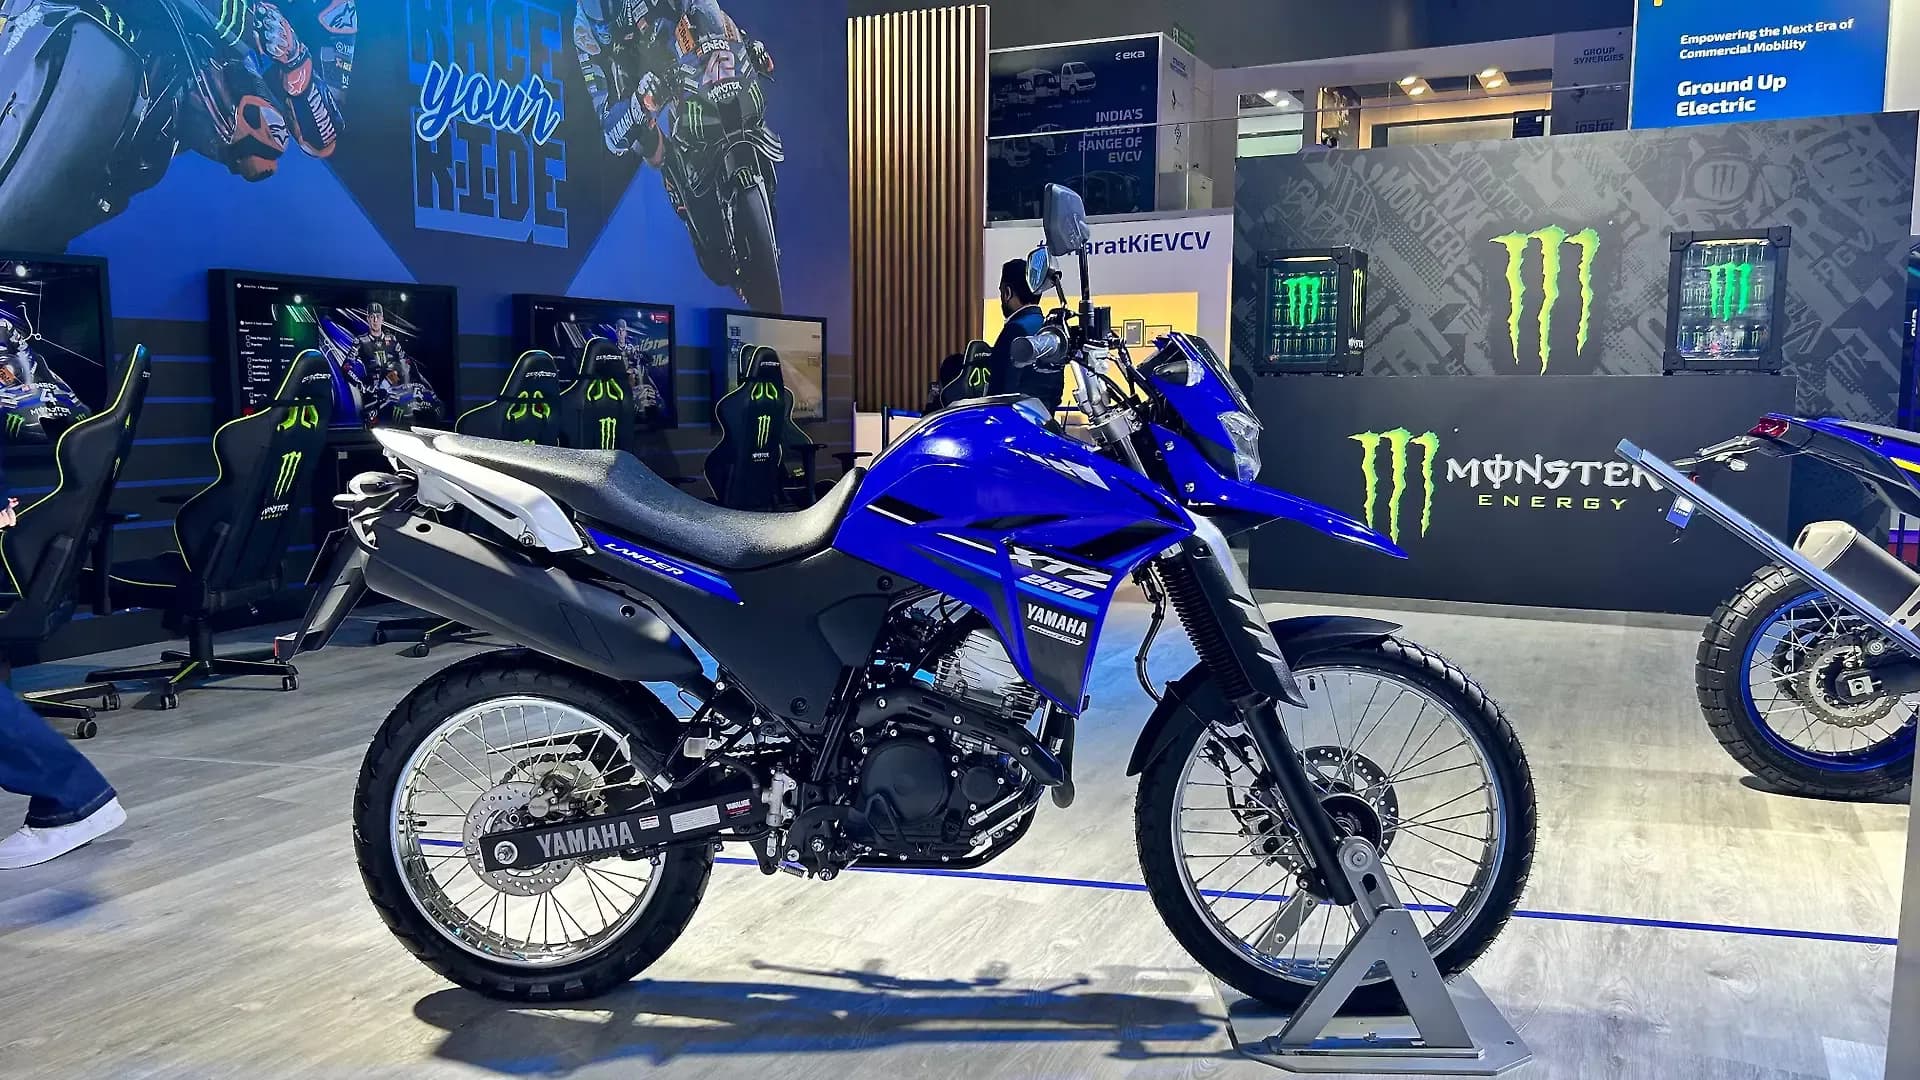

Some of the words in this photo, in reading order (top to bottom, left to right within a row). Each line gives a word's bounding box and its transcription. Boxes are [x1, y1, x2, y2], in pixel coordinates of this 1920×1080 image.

[1680, 29, 1757, 46] Empowering
[1759, 26, 1780, 37] the
[1782, 23, 1814, 36] Next
[1815, 21, 1837, 32] Era
[1839, 18, 1855, 29] of
[702, 39, 730, 54] ENEOS
[1679, 44, 1752, 60] Commercial
[1753, 39, 1806, 52] Mobility
[1573, 53, 1625, 65] SYNERGIES
[1677, 75, 1753, 97] Ground
[1757, 73, 1787, 92] Up
[416, 60, 561, 146] your
[1676, 96, 1757, 117] Electric
[1095, 108, 1144, 123] INDIA'S
[1078, 138, 1122, 152] RANGE
[1125, 136, 1143, 148] OF
[1108, 150, 1143, 163] EVCV
[412, 110, 568, 246] RIDE
[1477, 494, 1628, 512] ENERGY
[604, 543, 685, 575] LANDER
[1009, 546, 1113, 590] XTZ
[1019, 573, 1096, 600] 250
[1027, 602, 1088, 638] YAMAHA
[536, 821, 635, 858] YAMAHA
